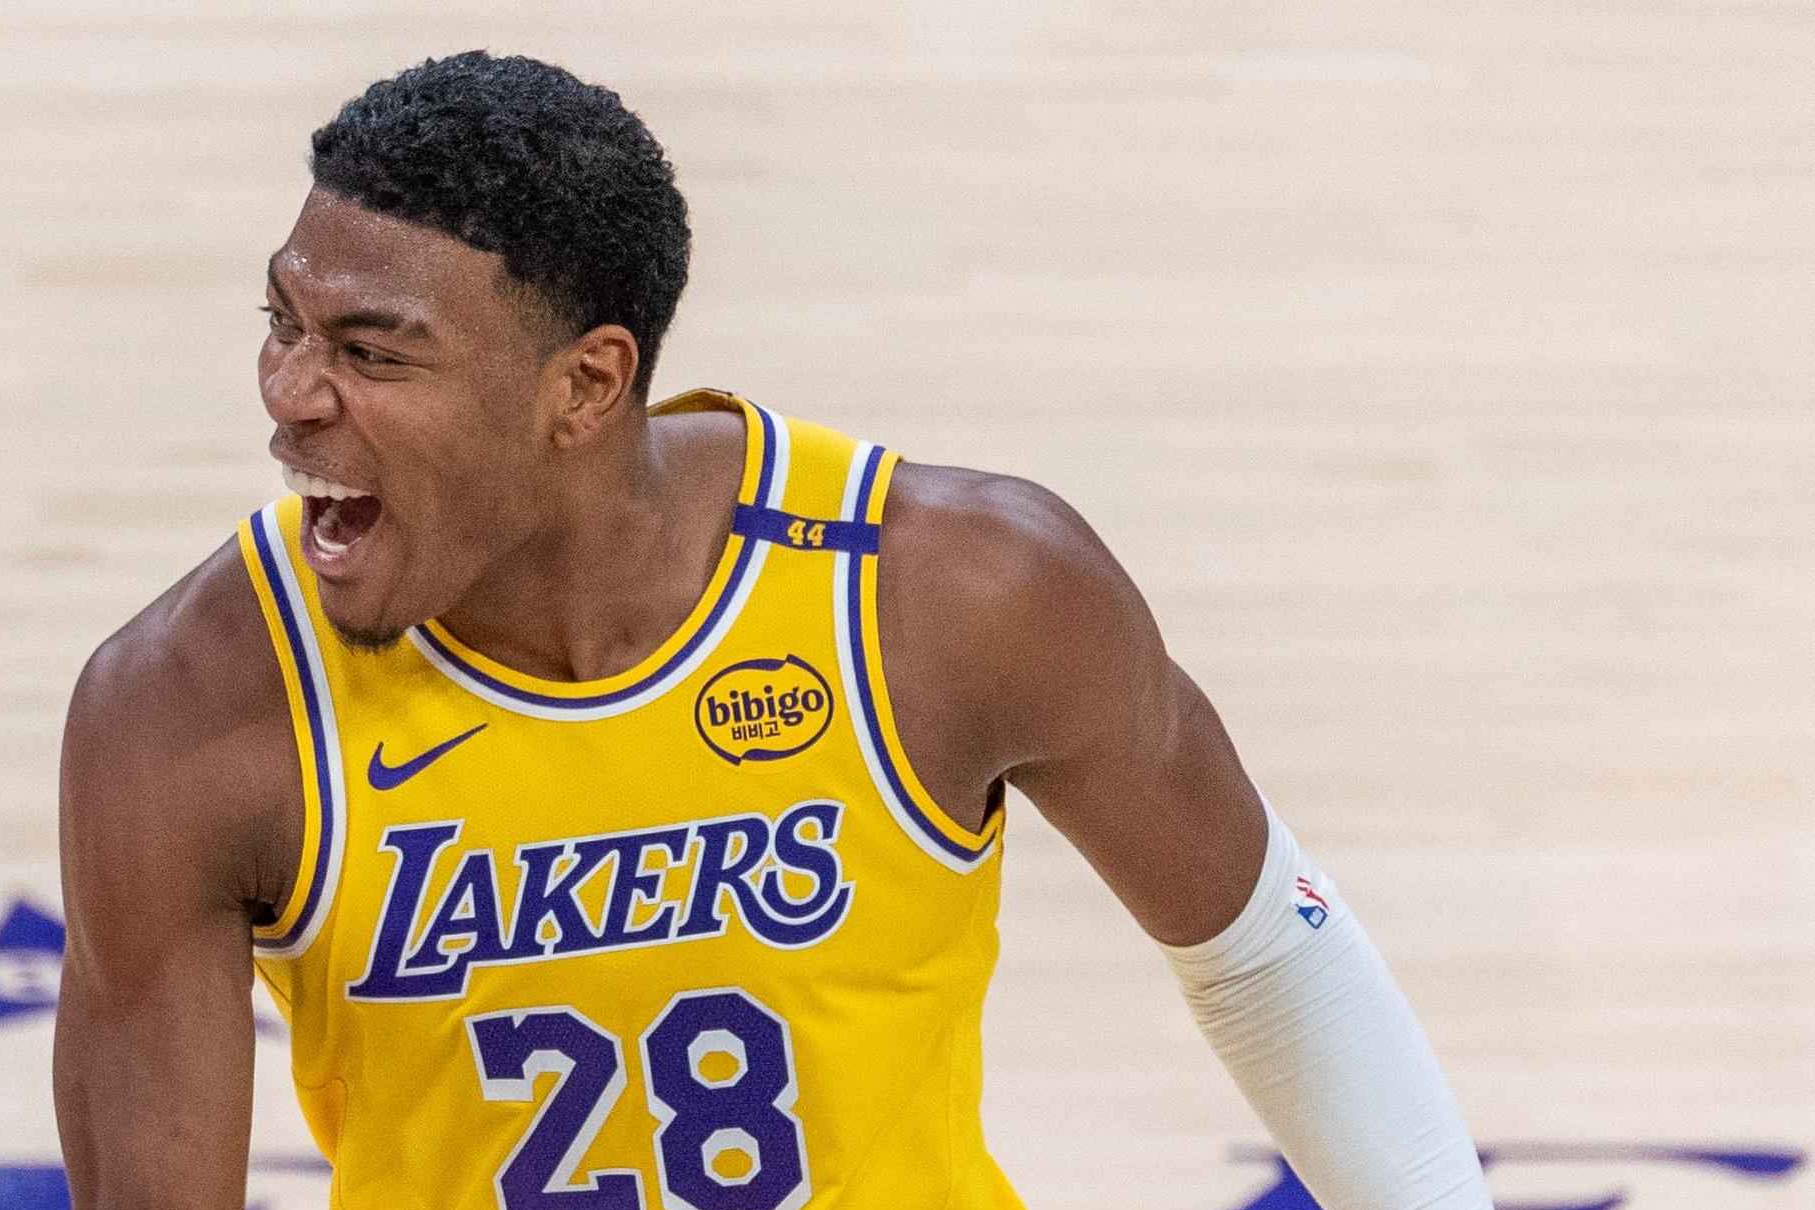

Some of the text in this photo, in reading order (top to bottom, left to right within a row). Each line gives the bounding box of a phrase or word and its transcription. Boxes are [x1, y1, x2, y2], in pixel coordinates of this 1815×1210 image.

[787, 520, 826, 546] 44
[706, 685, 824, 727] bibigo
[732, 721, 782, 742] 비비고
[344, 799, 857, 1004] LAKERS
